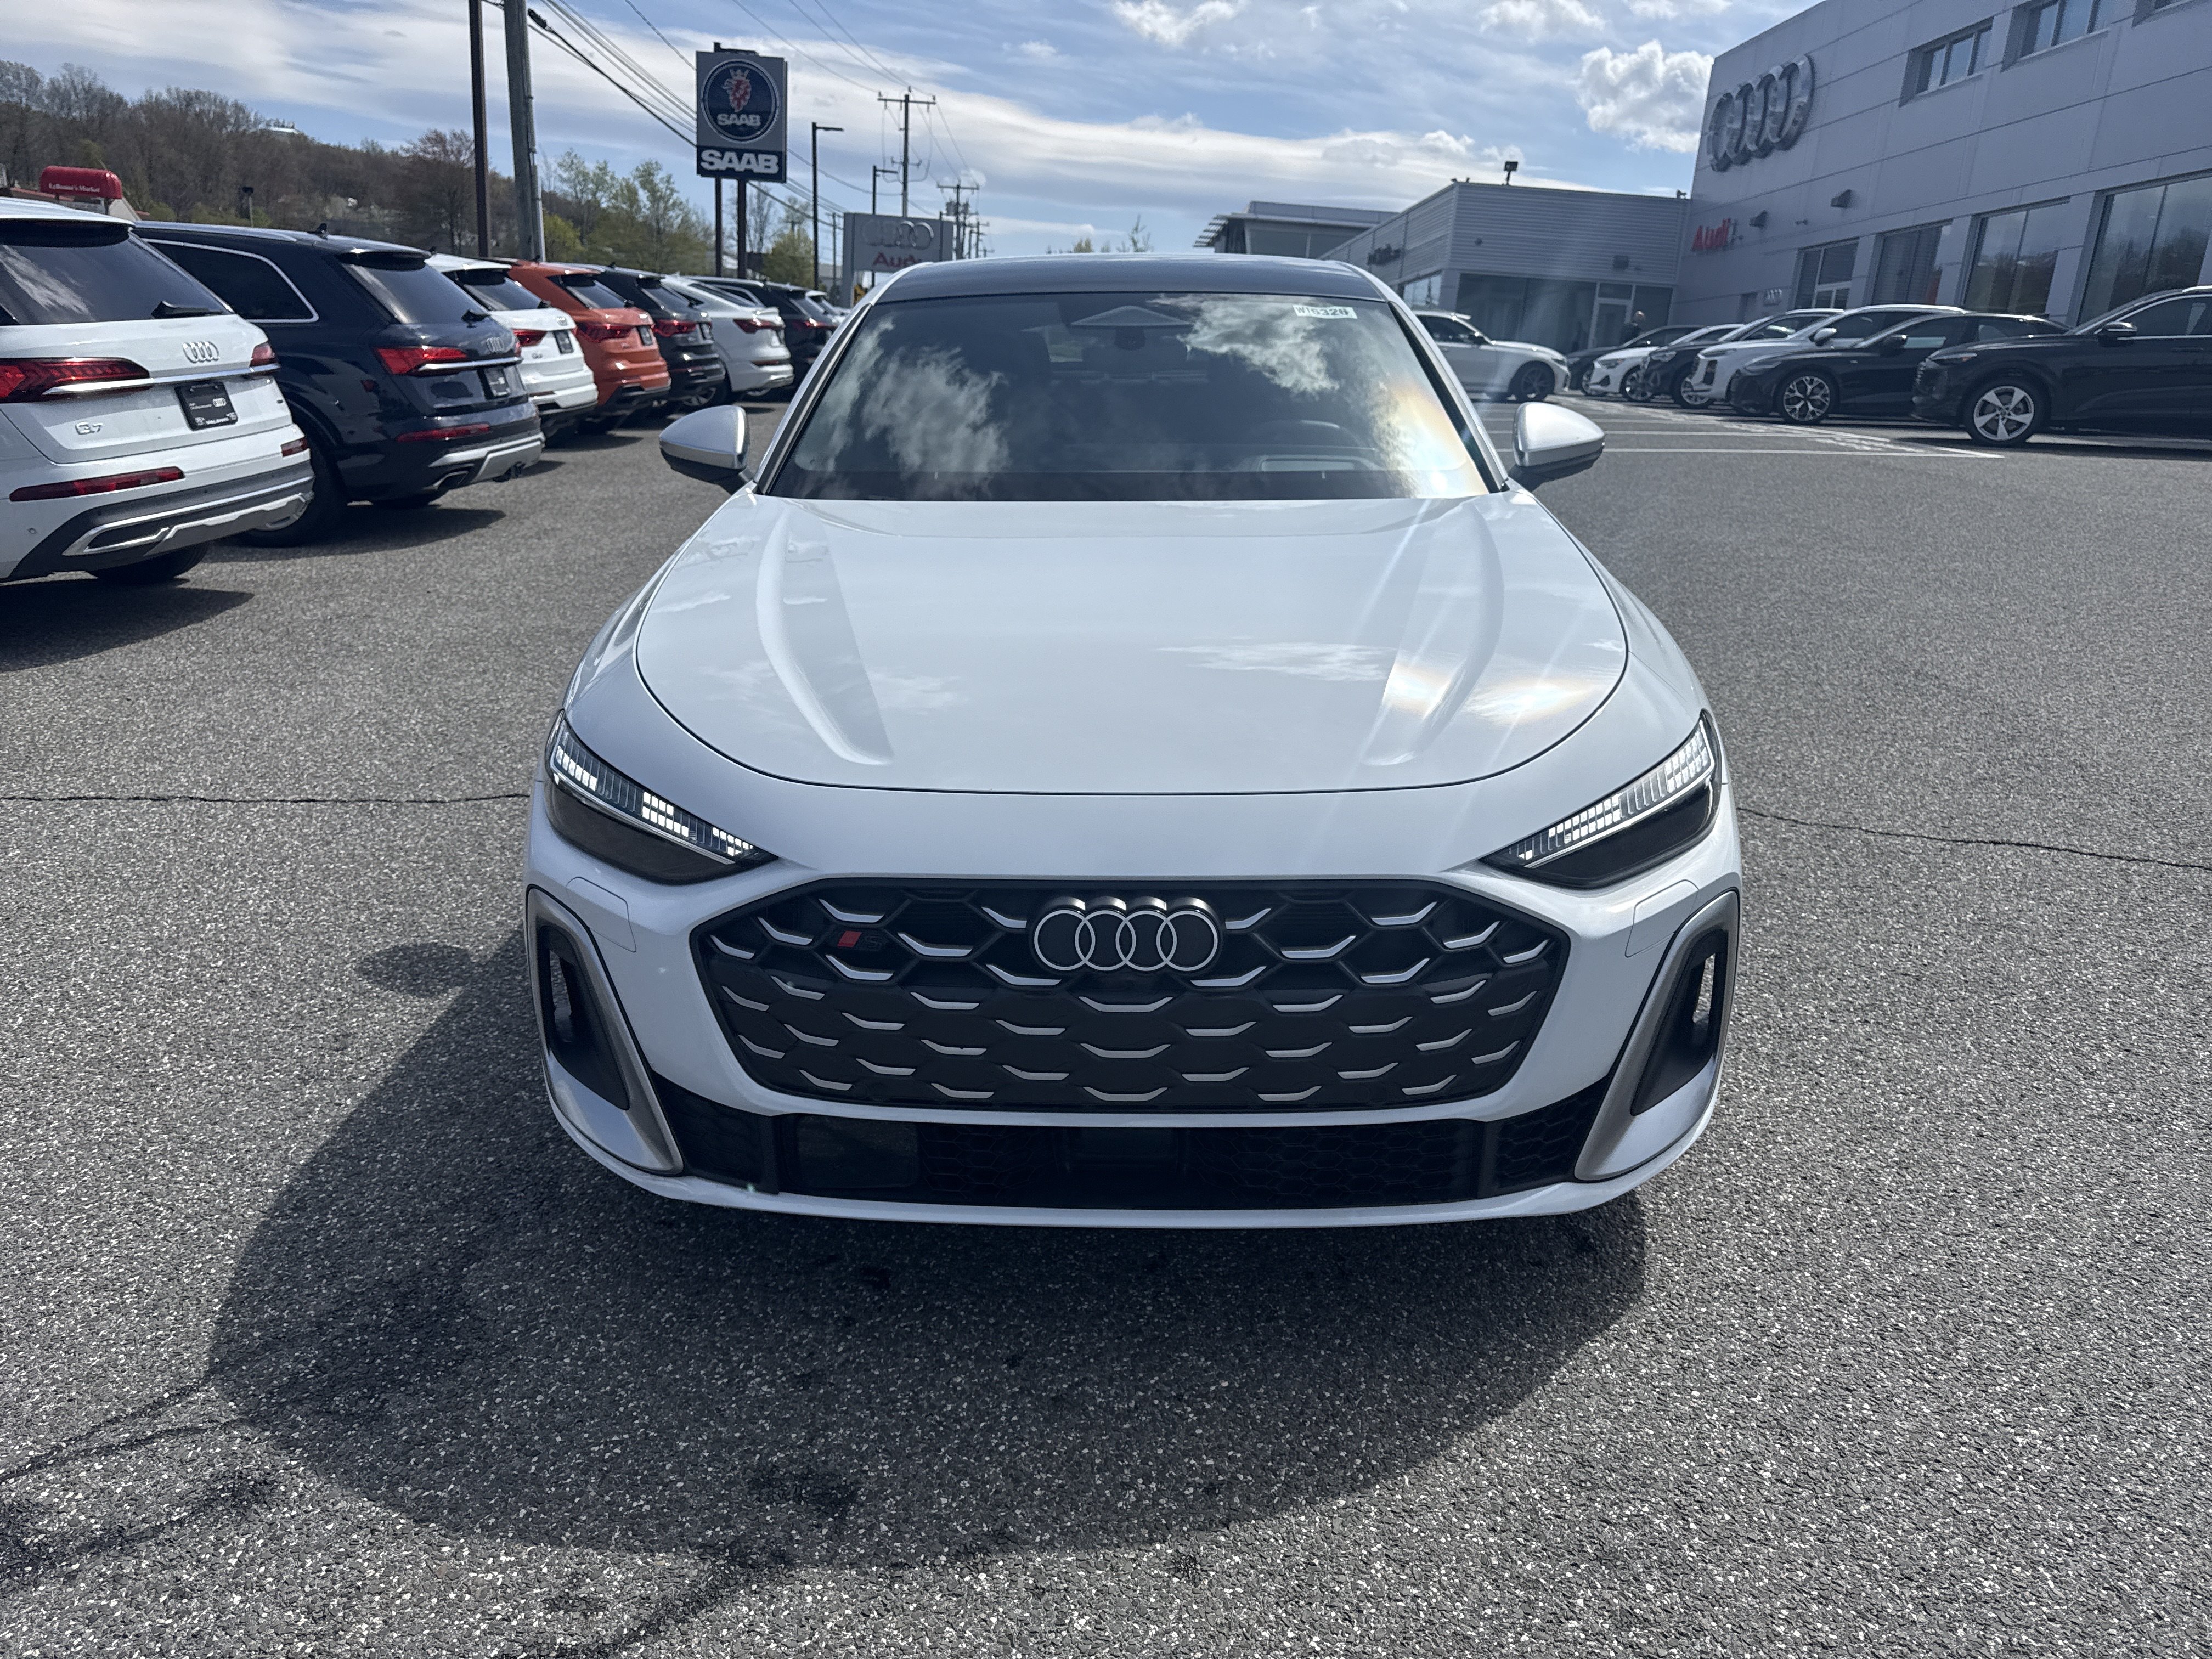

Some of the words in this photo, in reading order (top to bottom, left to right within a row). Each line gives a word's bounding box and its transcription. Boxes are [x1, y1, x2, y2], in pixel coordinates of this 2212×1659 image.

[716, 113, 761, 127] SAAB
[700, 149, 780, 174] SAAB
[75, 421, 104, 435] Q7
